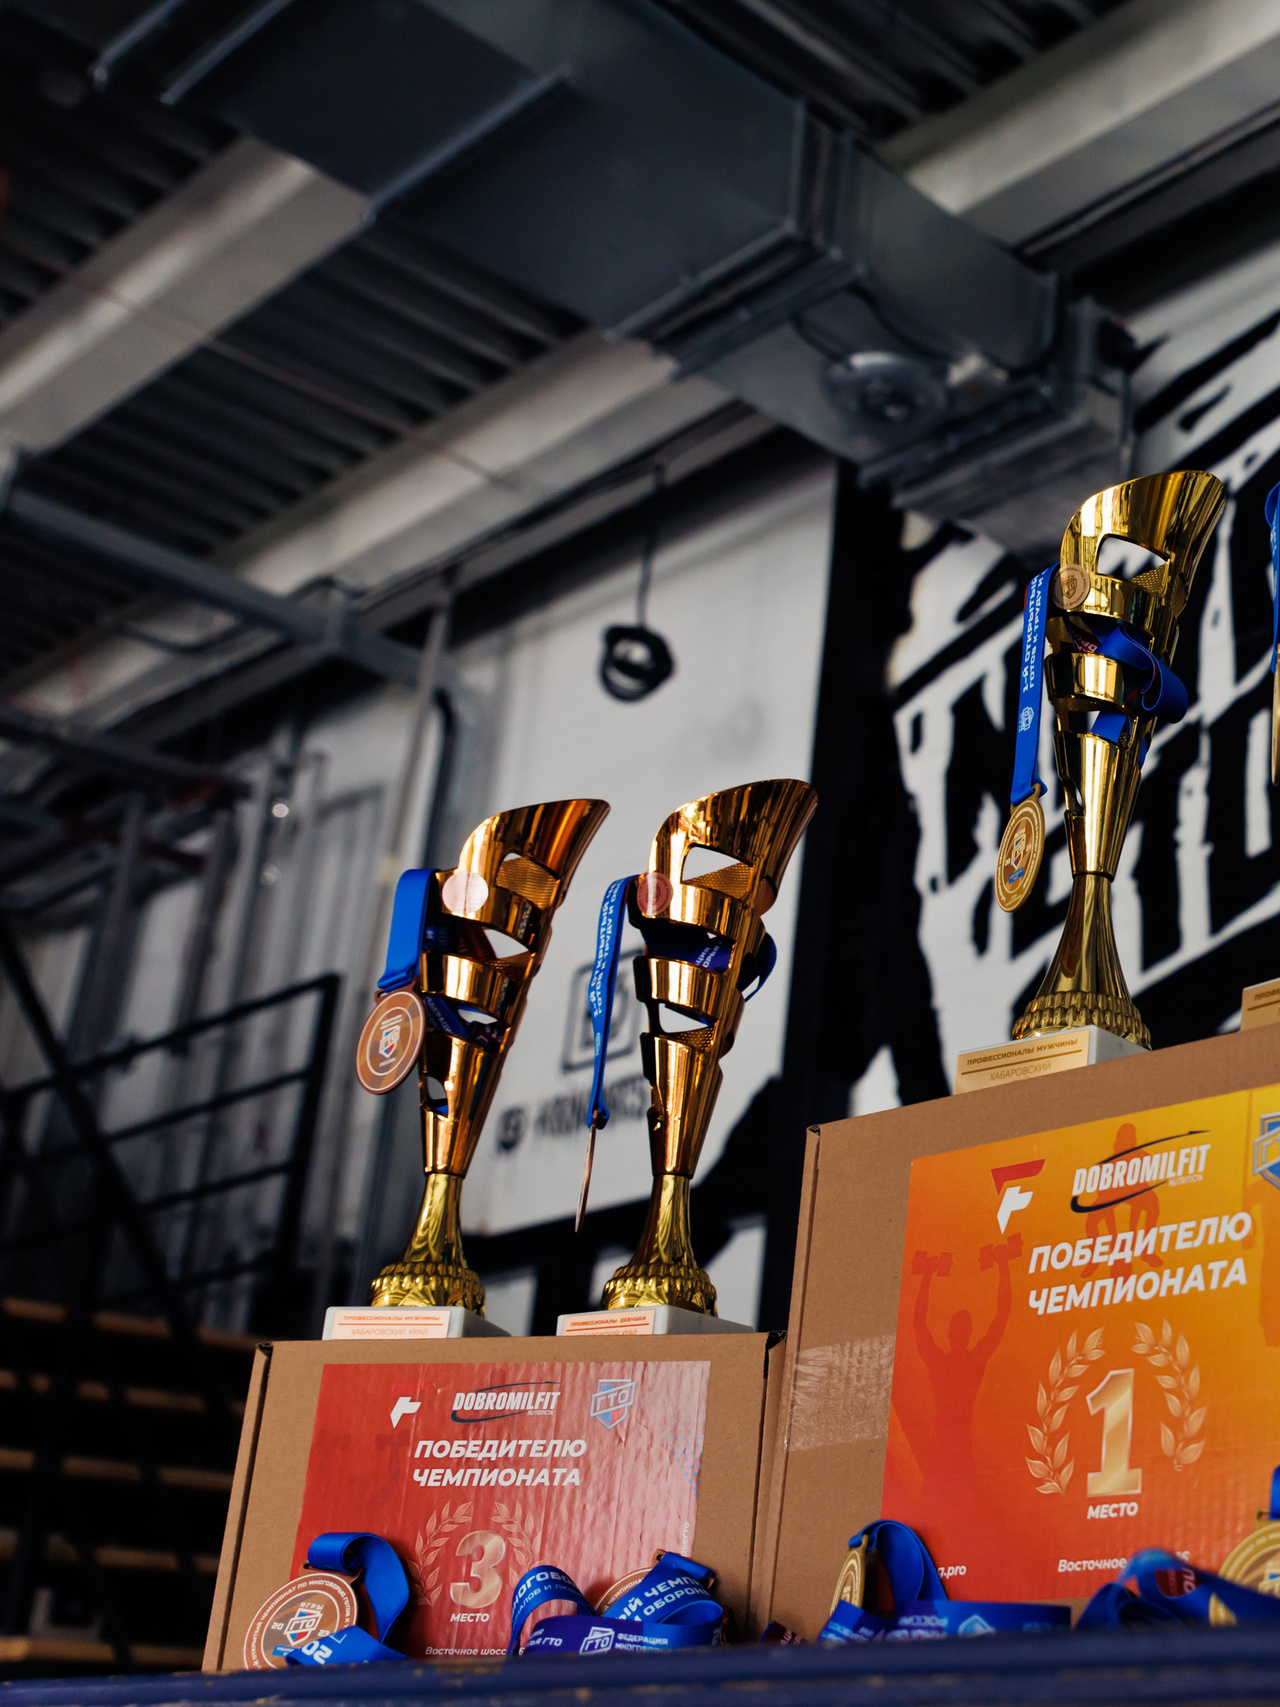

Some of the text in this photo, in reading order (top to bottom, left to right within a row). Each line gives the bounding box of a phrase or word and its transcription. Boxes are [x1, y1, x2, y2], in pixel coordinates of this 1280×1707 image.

[1024, 575, 1039, 662] ОТКРЫТЫЙ
[591, 901, 610, 986] ОТКРЫТЫЙ
[595, 972, 603, 1014] ГОТОВ
[603, 918, 613, 959] ТРУДУ
[967, 1039, 1078, 1066] ПРОФЕССИОНАЛЫ МУЖЧИНЫ
[989, 1060, 1052, 1081] ХАБАРОВСКИЙ
[1072, 1144, 1211, 1196] DOBROMILFIT
[1028, 1211, 1252, 1274] ПОБЕДИТЕЛЮ
[1028, 1258, 1247, 1316] ЧЕМПИОНАТА
[350, 1328, 428, 1336] ХАБАРОВСКИЙ КРАЙ
[570, 1318, 618, 1327] ПРОФЕССИОНАЛЫ
[453, 1391, 561, 1411] DOBROMILFIT
[596, 1389, 629, 1411] ГТО
[1086, 1368, 1142, 1498] 1
[414, 1439, 587, 1461] ПОБЕДИТЕЛЮ
[413, 1468, 581, 1487] ЧЕМПИОНАТА
[1087, 1501, 1139, 1520] МЕСТО
[450, 1529, 506, 1609] 3
[1058, 1557, 1128, 1573] Восточное
[261, 1588, 297, 1621] ЧЕМПИОНАТ
[297, 1581, 307, 1589] ПО
[299, 1602, 324, 1611] ИГРЫ
[271, 1621, 284, 1630] 20
[290, 1618, 317, 1631] ГТО
[450, 1613, 490, 1623] МЕСТО
[542, 1637, 564, 1647] ГТО
[585, 1637, 610, 1651] ГТО
[617, 1633, 668, 1645] ФЕДЕРАЦИЯ
[425, 1646, 478, 1656] Восточное
